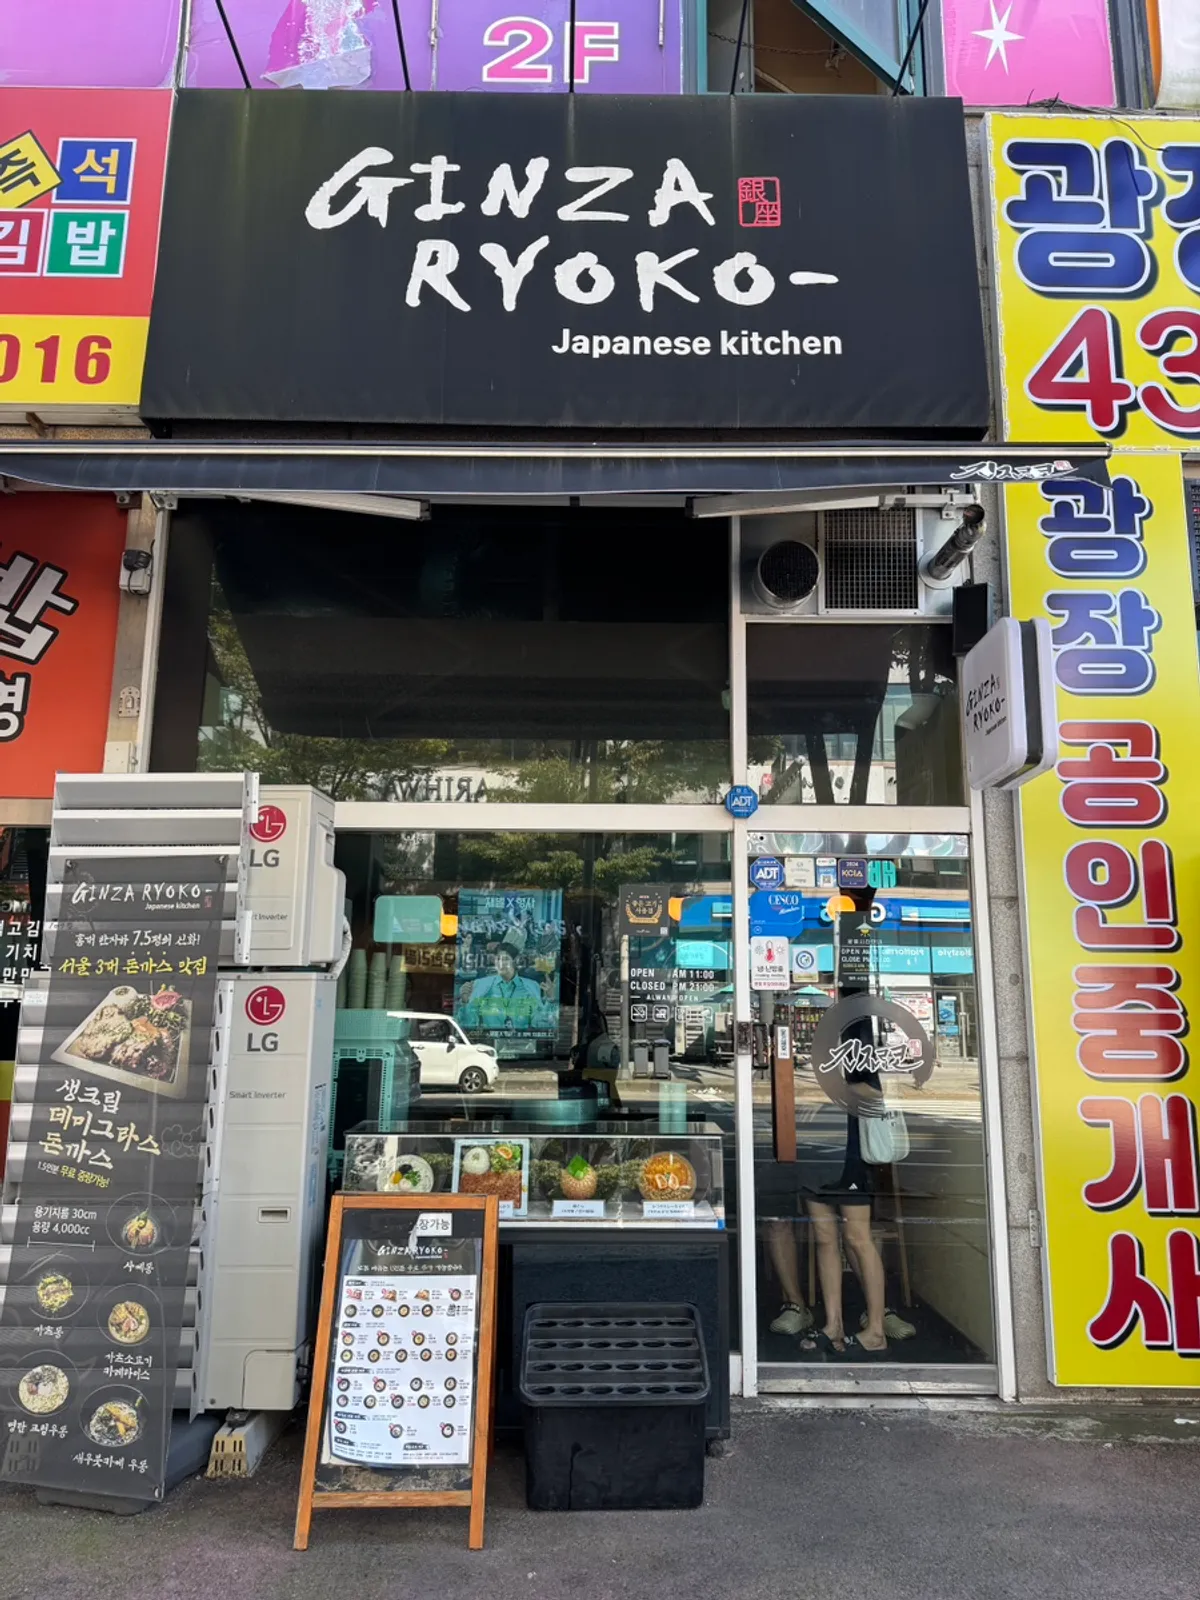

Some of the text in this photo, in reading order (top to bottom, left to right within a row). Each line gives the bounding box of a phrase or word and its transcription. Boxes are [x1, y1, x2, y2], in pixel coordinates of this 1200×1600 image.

[483, 16, 620, 84] 2F
[305, 146, 714, 229] GINZA
[552, 328, 842, 356] Japanese kitchen
[731, 796, 753, 807] ADT
[249, 849, 280, 867] LG
[756, 868, 778, 879] ADT
[71, 882, 135, 904] GINZA
[144, 901, 200, 911] Japanese kitchen
[1036, 474, 1200, 1354] 광장 공인중개사
[59, 956, 208, 977] 서울 3대 돈까스 맛집
[630, 968, 715, 980] OPEN AM 11:00
[630, 981, 715, 992] CLOSED PM 21:00
[246, 1032, 279, 1052] LG
[56, 1078, 122, 1114] 생크림
[229, 1091, 252, 1099] Smart
[49, 1105, 162, 1156] 데미그라스
[39, 1132, 114, 1170] 돈까스
[71, 1207, 97, 1220] 30cm
[32, 1221, 90, 1235] 용량 4,000cc
